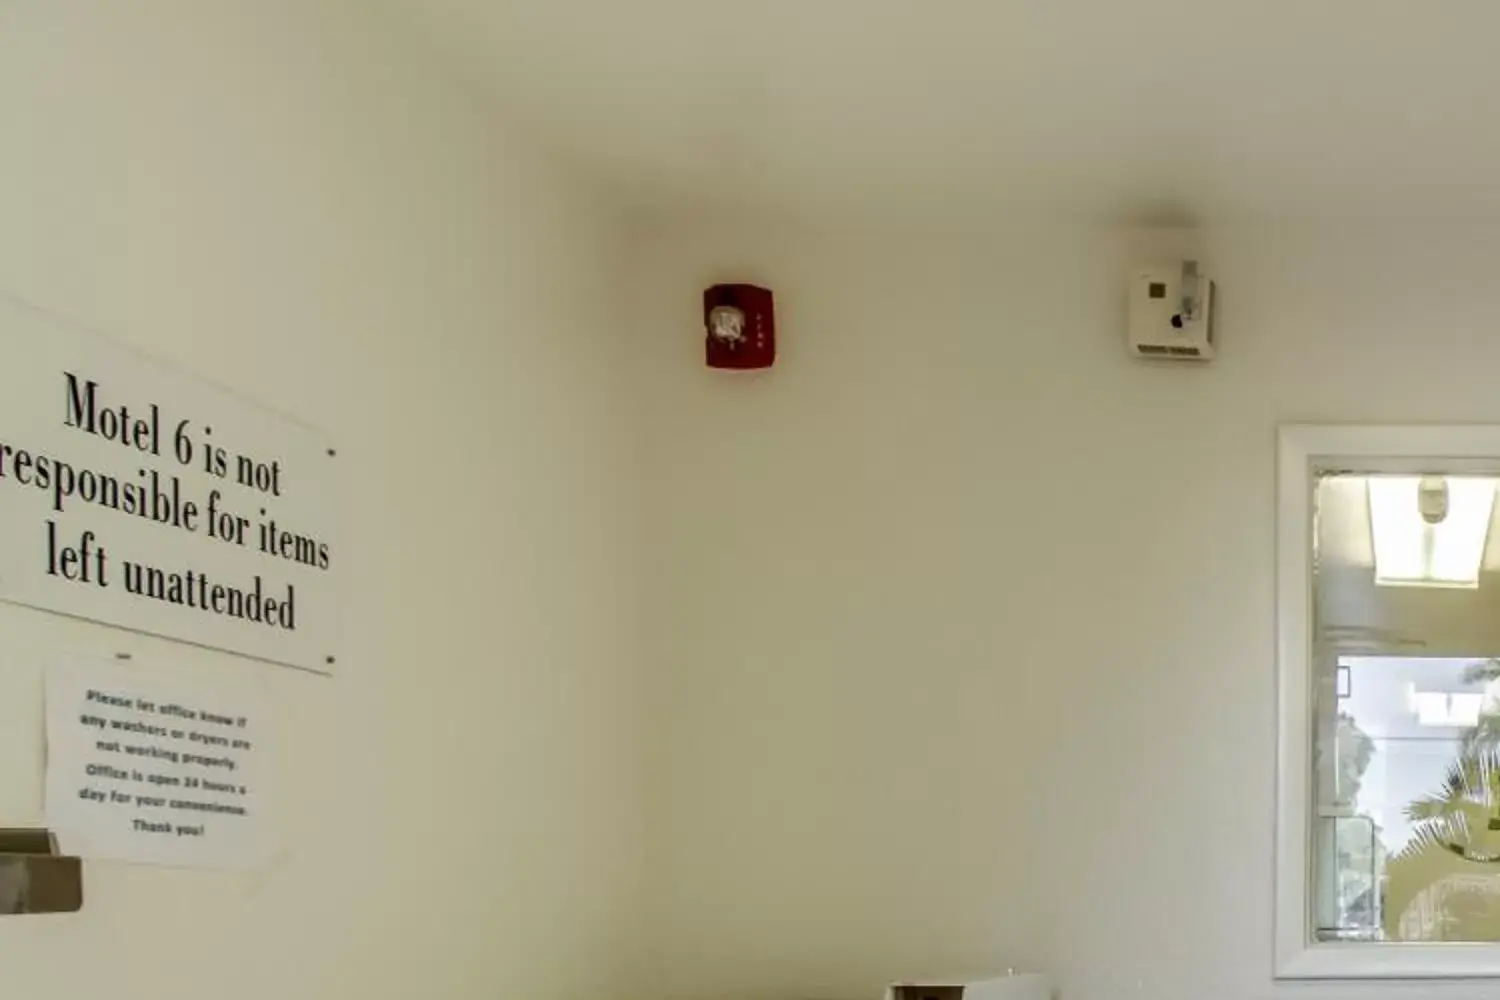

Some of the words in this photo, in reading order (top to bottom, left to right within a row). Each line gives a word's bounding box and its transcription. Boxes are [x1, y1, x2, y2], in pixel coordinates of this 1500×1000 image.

[63, 372, 160, 456] Motel
[174, 419, 193, 465] 6
[205, 427, 227, 478] is
[237, 455, 283, 497] not
[0, 441, 198, 532] responsible
[207, 490, 250, 546] for
[259, 509, 330, 571] items
[45, 519, 109, 588] left
[123, 560, 297, 631] unattended
[86, 689, 133, 709] Please
[137, 700, 155, 712] let
[160, 704, 196, 719] office
[200, 710, 233, 726] know
[238, 717, 247, 727] if
[80, 714, 106, 729] any
[111, 719, 167, 736] washers
[171, 730, 185, 739] or
[189, 730, 229, 746] dryers
[232, 740, 250, 750] are
[97, 741, 120, 752] not
[125, 744, 178, 762] working
[86, 764, 128, 780] Office
[133, 769, 143, 781] is
[148, 773, 180, 787] open
[184, 777, 198, 788] 24
[203, 780, 235, 793] hours
[239, 786, 246, 795] a
[79, 789, 106, 802] day
[111, 791, 131, 803] for
[137, 796, 167, 807] your
[132, 819, 172, 833] Thank
[176, 824, 204, 837] you!
